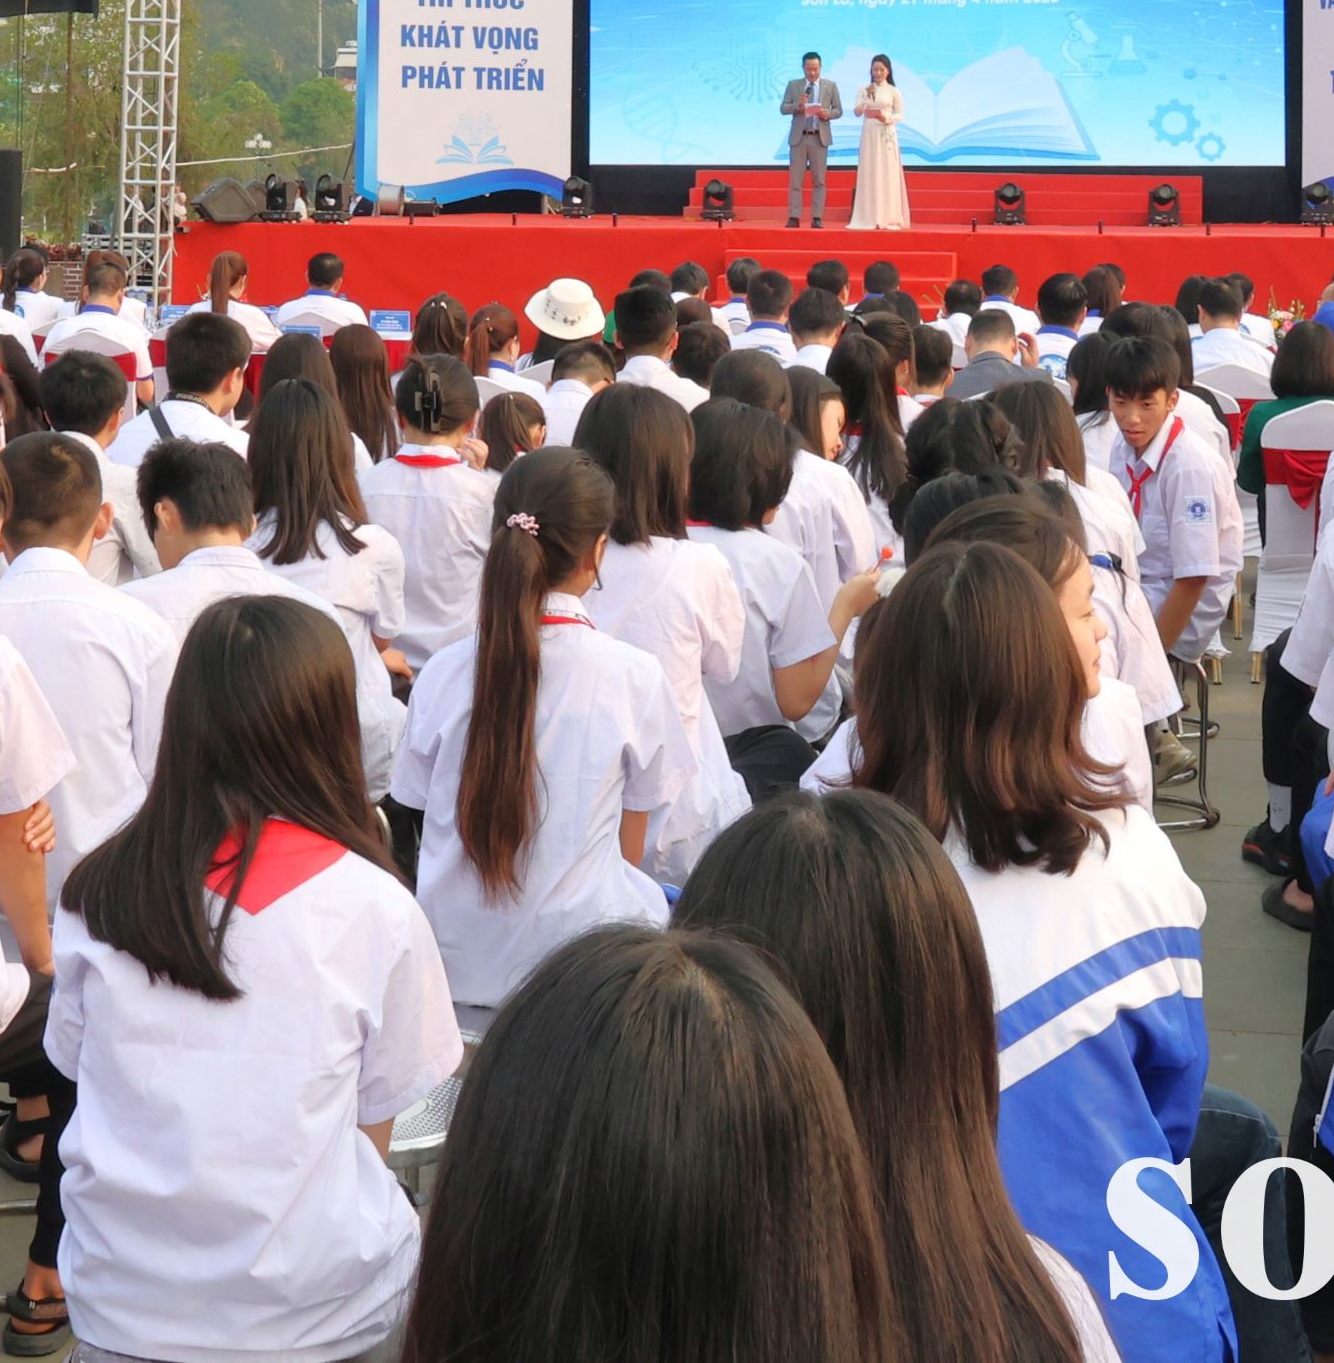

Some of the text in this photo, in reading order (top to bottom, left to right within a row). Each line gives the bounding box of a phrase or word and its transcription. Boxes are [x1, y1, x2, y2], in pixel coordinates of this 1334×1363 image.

[401, 20, 538, 54] KHÁT VỌNG
[401, 58, 544, 91] PHÁT TRIỂN
